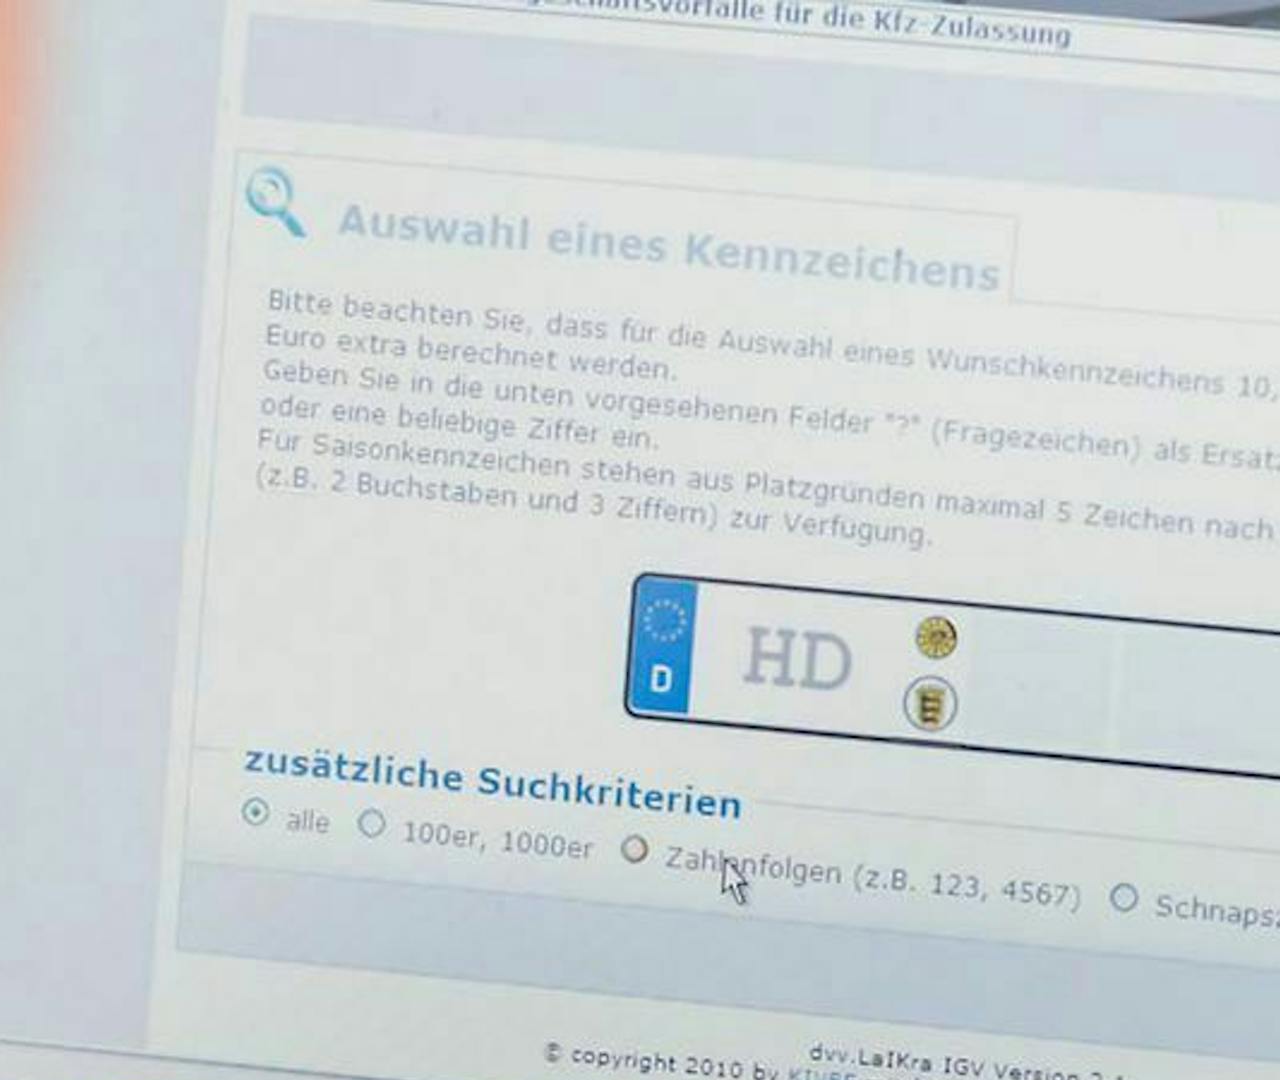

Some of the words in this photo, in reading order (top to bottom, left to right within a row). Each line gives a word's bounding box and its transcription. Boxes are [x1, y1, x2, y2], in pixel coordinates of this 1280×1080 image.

[823, 5, 864, 29] die
[874, 10, 1071, 49] Kfz-Zulassung
[338, 204, 531, 252] Auswahl
[547, 221, 669, 265] eines
[685, 232, 1002, 294] Kennzeichens
[266, 323, 328, 352] Euro
[337, 334, 409, 359] extra
[416, 335, 560, 373] berechnet
[569, 354, 679, 383] werden.
[268, 288, 335, 318] Bitte
[343, 293, 475, 329] beachten
[483, 307, 534, 337] Sie,
[545, 312, 610, 342] dass
[667, 323, 709, 352] die
[718, 329, 835, 361] Auswahl
[843, 344, 917, 370] eines
[926, 347, 1226, 398] Wunschkennzeichens
[261, 394, 323, 421] oder
[331, 403, 388, 428] eine
[397, 403, 518, 444] beliebige
[527, 417, 600, 447] Ziffer
[611, 429, 660, 452] ein.
[263, 358, 351, 388] Geben
[359, 366, 402, 394] Sie
[410, 376, 435, 396] in
[444, 373, 485, 401] die
[494, 383, 576, 409] unten
[585, 392, 781, 427] vorgesehenen
[789, 405, 876, 437] Felder
[932, 418, 1143, 465] (Fragezeichen)
[1154, 440, 1193, 466] als
[256, 461, 319, 492] (z.B.
[331, 469, 348, 495] 2
[357, 471, 519, 510] Buchstaben
[527, 489, 581, 516] und
[590, 493, 607, 518] 3
[616, 495, 719, 534] Ziffern)
[730, 509, 774, 533] zur
[312, 433, 573, 479] Saisonkennzeichen
[581, 460, 678, 489] stehen
[686, 471, 736, 495] aus
[935, 493, 1047, 522] maximal
[1057, 500, 1074, 525] 5
[1083, 503, 1196, 537] Zeichen
[1205, 518, 1276, 543] nach
[650, 664, 673, 693] D
[743, 624, 854, 692] HD
[245, 749, 465, 794] zusätzliche
[478, 767, 743, 821] Suchkriterien
[287, 809, 332, 837] alle
[405, 821, 488, 855] 100er,
[502, 831, 596, 862] 1000er
[853, 863, 917, 895] (z.B.
[931, 873, 989, 904] 123,
[1001, 880, 1083, 916] 4567)
[571, 1049, 678, 1077] copyright
[943, 1056, 986, 1080] IGV
